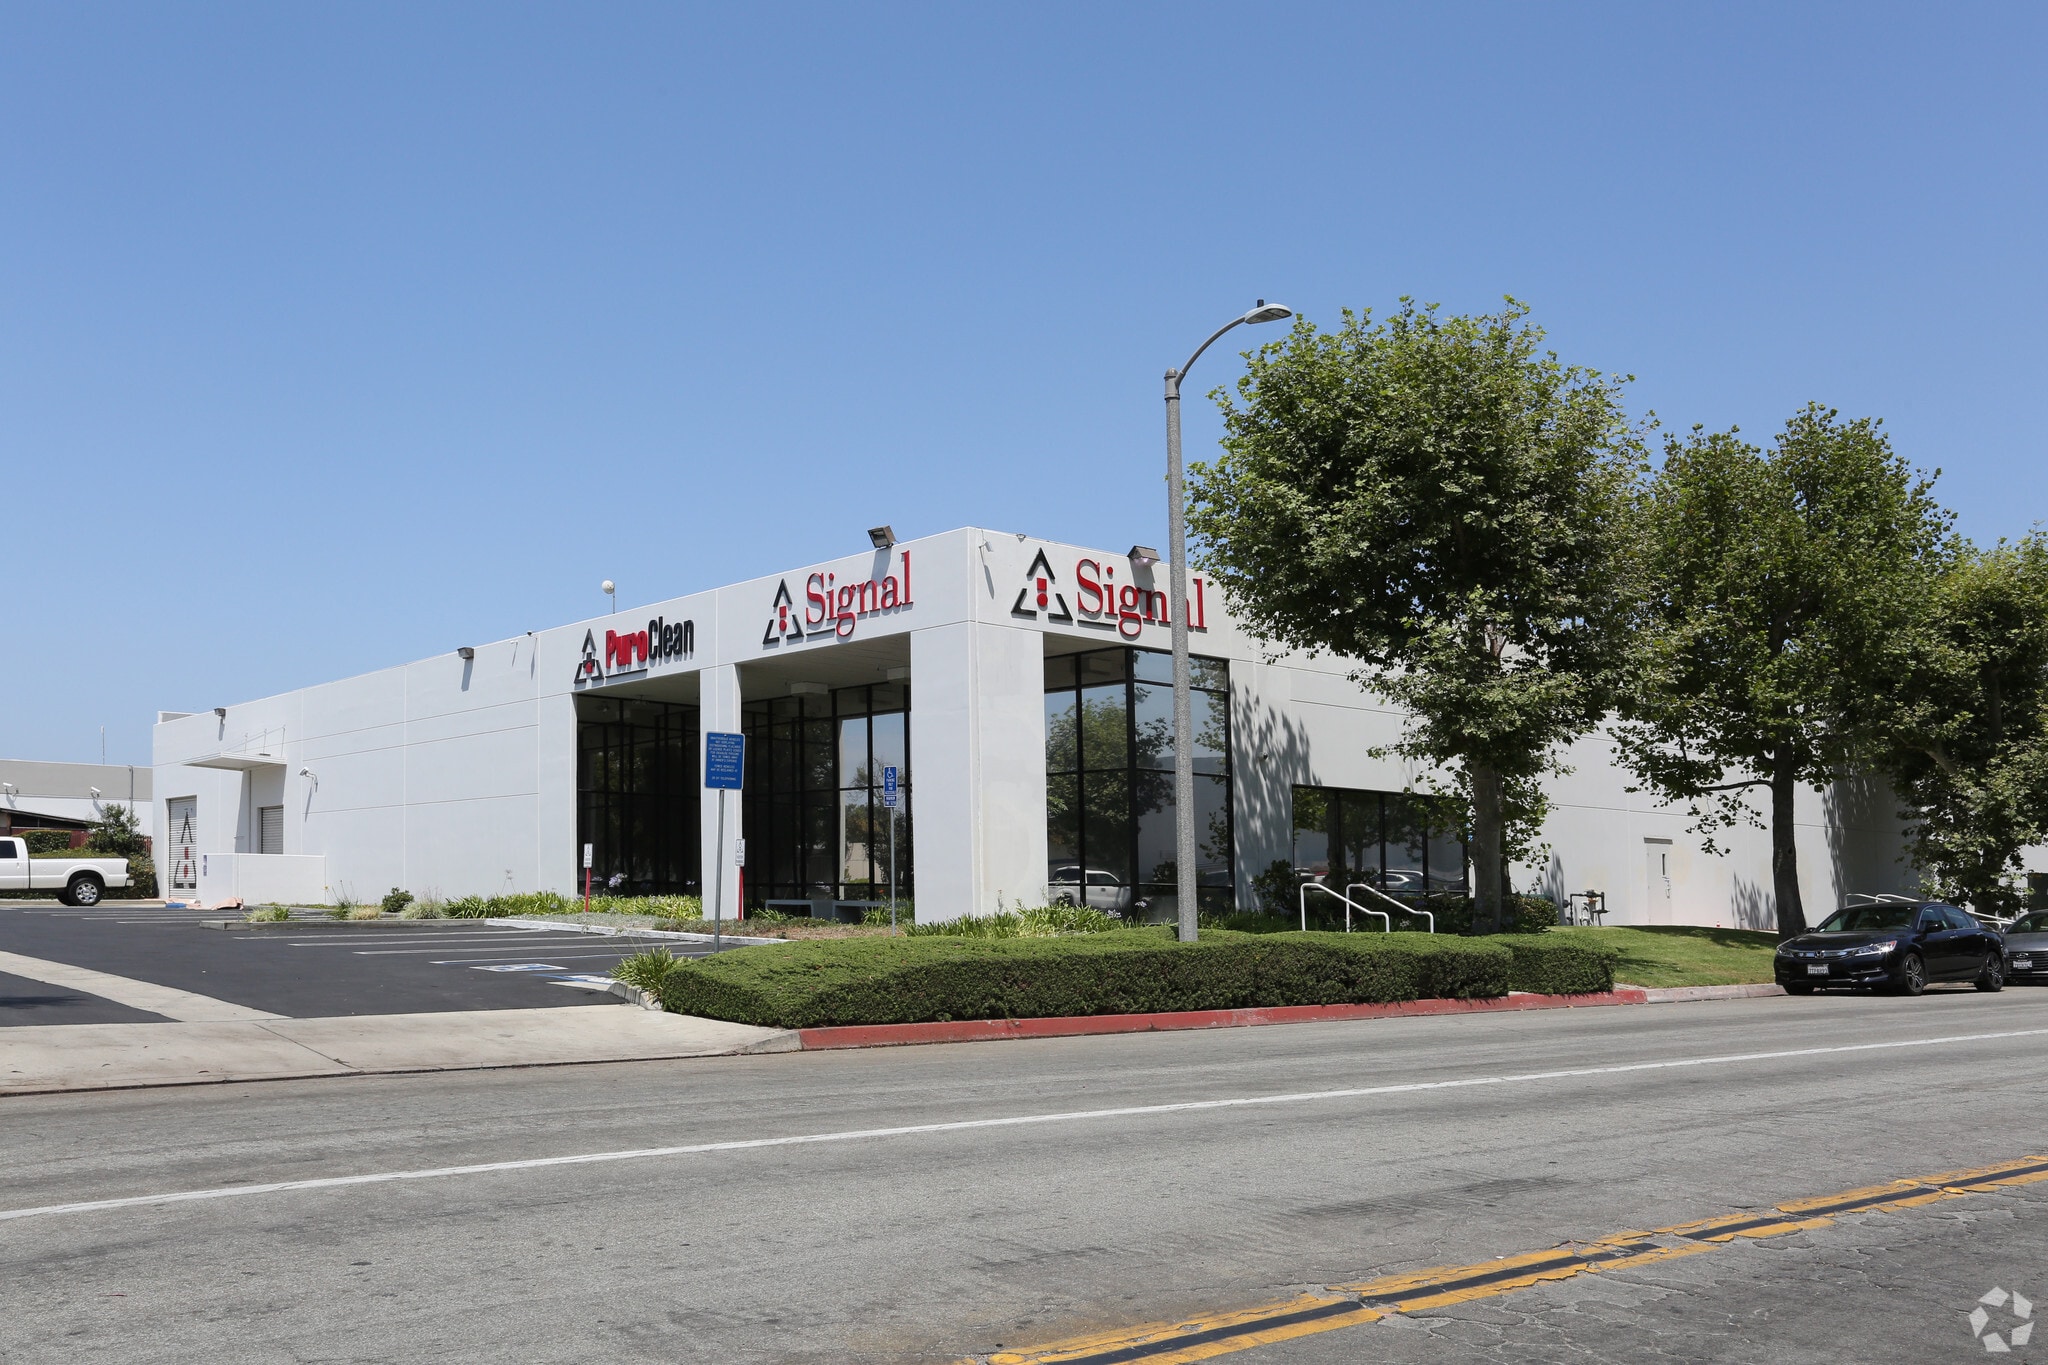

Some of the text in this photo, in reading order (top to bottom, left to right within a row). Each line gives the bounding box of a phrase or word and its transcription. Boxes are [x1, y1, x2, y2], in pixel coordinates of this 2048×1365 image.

[805, 550, 914, 637] Signal
[1076, 558, 1208, 637] Signl
[605, 616, 695, 669] PuroClean
